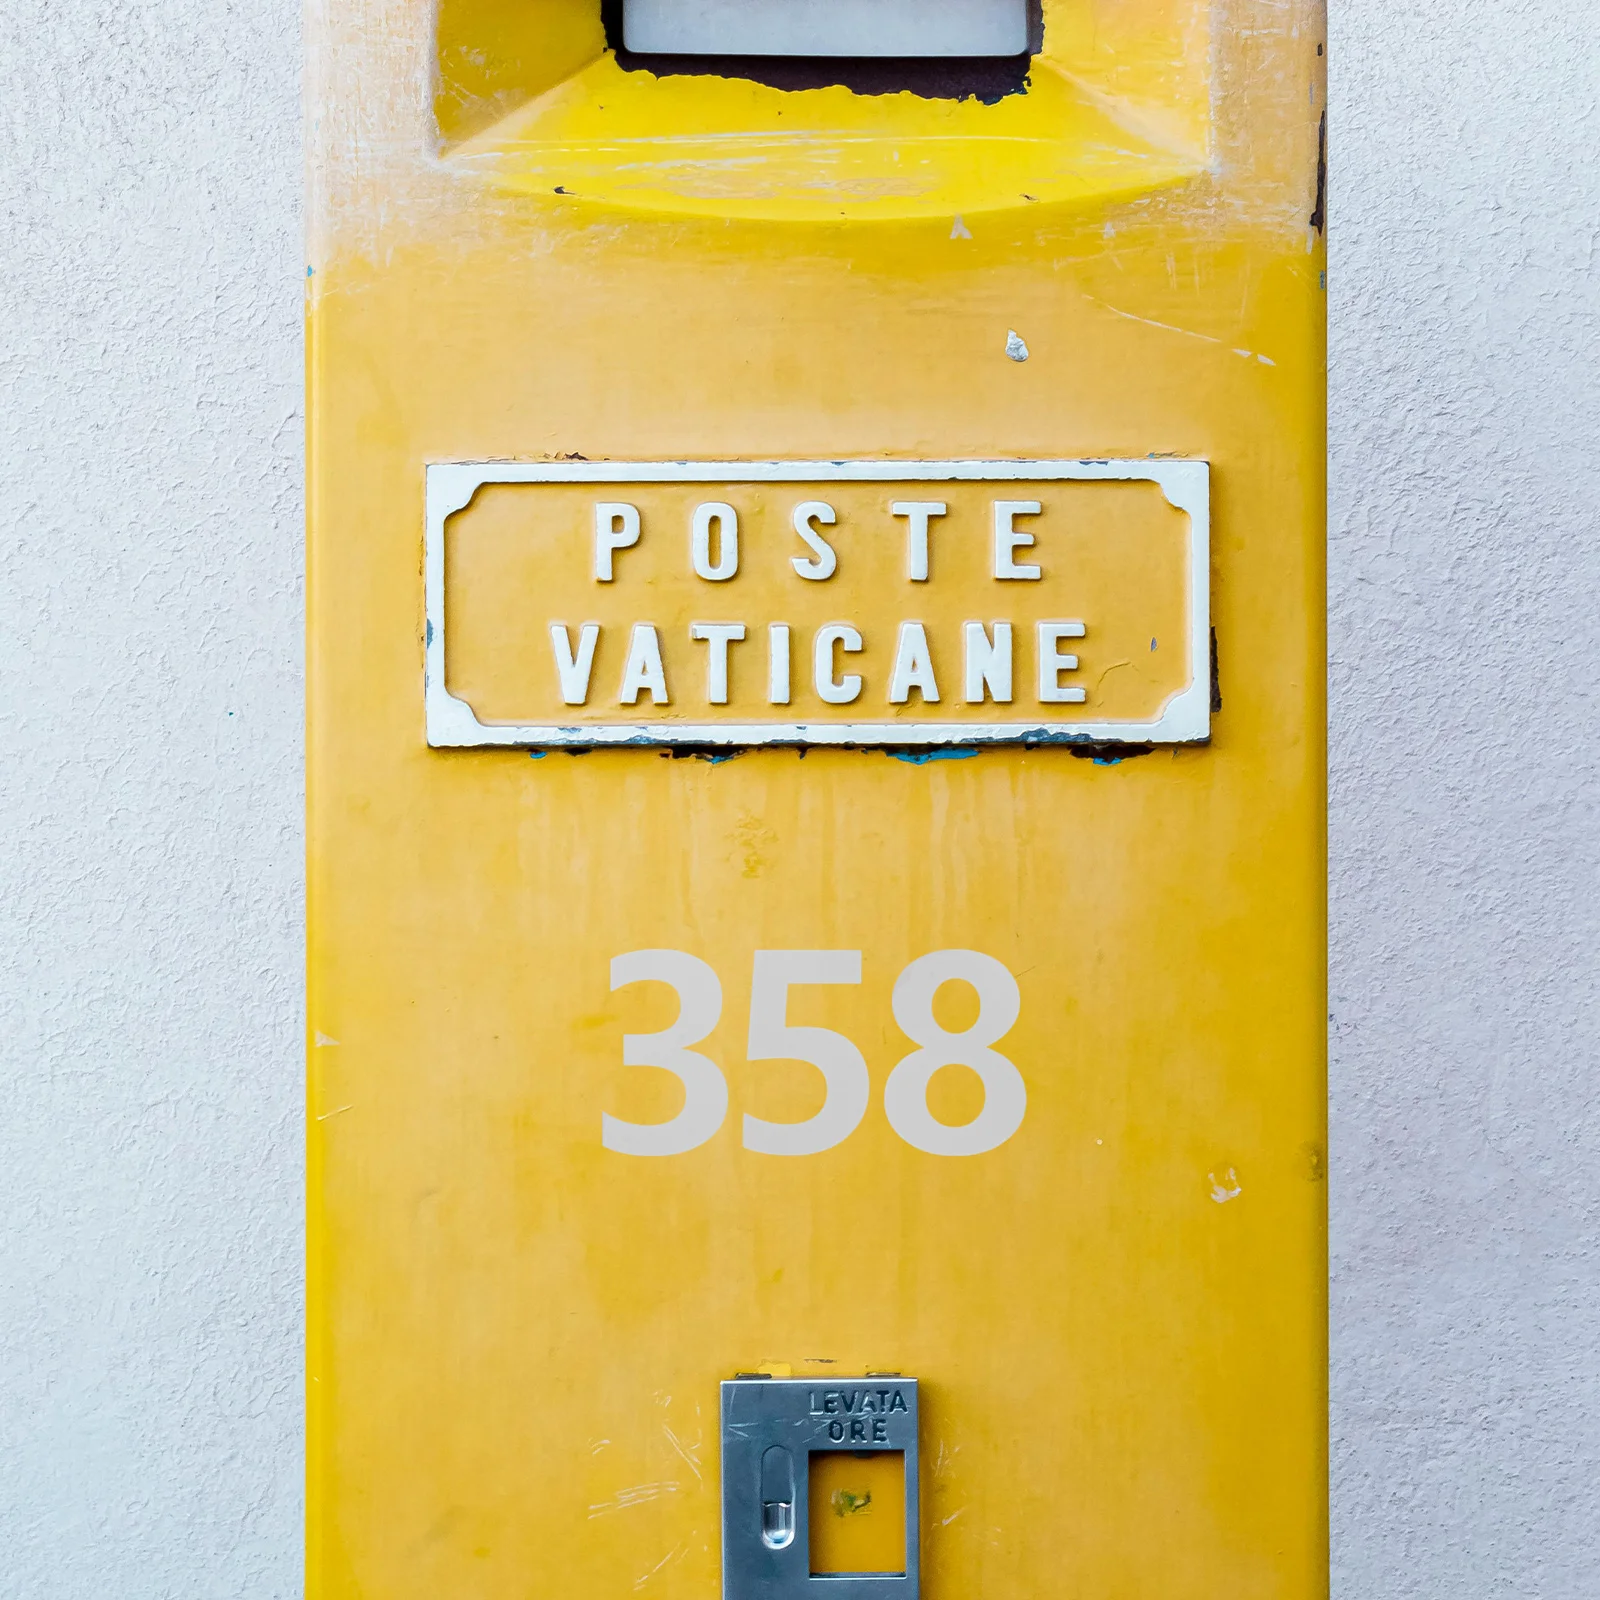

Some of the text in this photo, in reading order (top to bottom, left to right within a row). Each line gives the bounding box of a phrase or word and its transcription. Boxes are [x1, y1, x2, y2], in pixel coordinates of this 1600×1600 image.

[594, 500, 1042, 582] POSTE
[549, 622, 1087, 706] VATICANE
[808, 1390, 909, 1415] LEVATA
[828, 1419, 889, 1443] ORE
